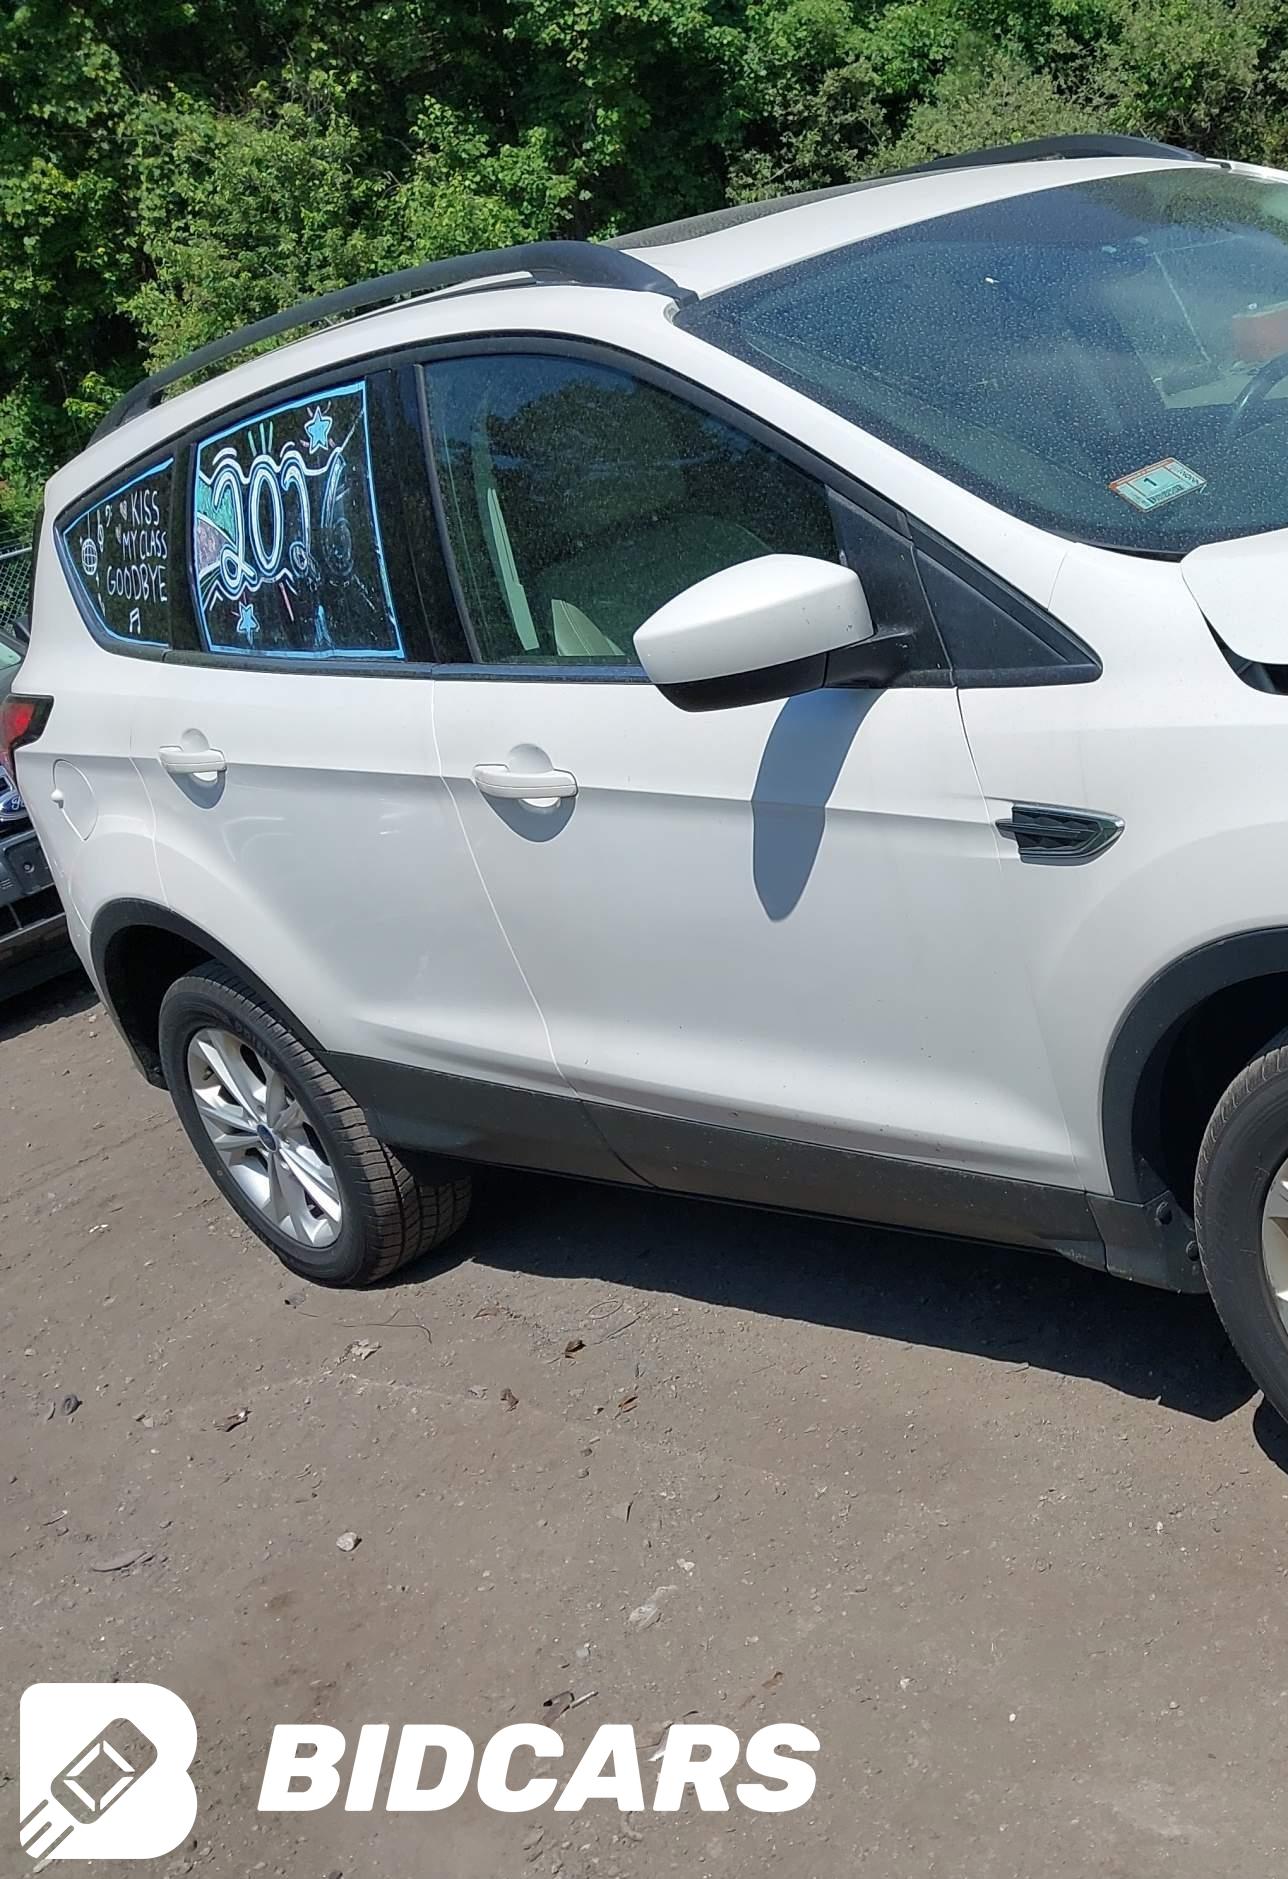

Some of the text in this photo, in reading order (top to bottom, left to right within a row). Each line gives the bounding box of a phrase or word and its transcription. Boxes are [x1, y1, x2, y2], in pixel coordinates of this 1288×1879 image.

[1143, 477, 1157, 487] 1
[130, 488, 160, 527] KISS
[121, 529, 168, 561] MY CLASS
[106, 563, 168, 603] GOODBYE
